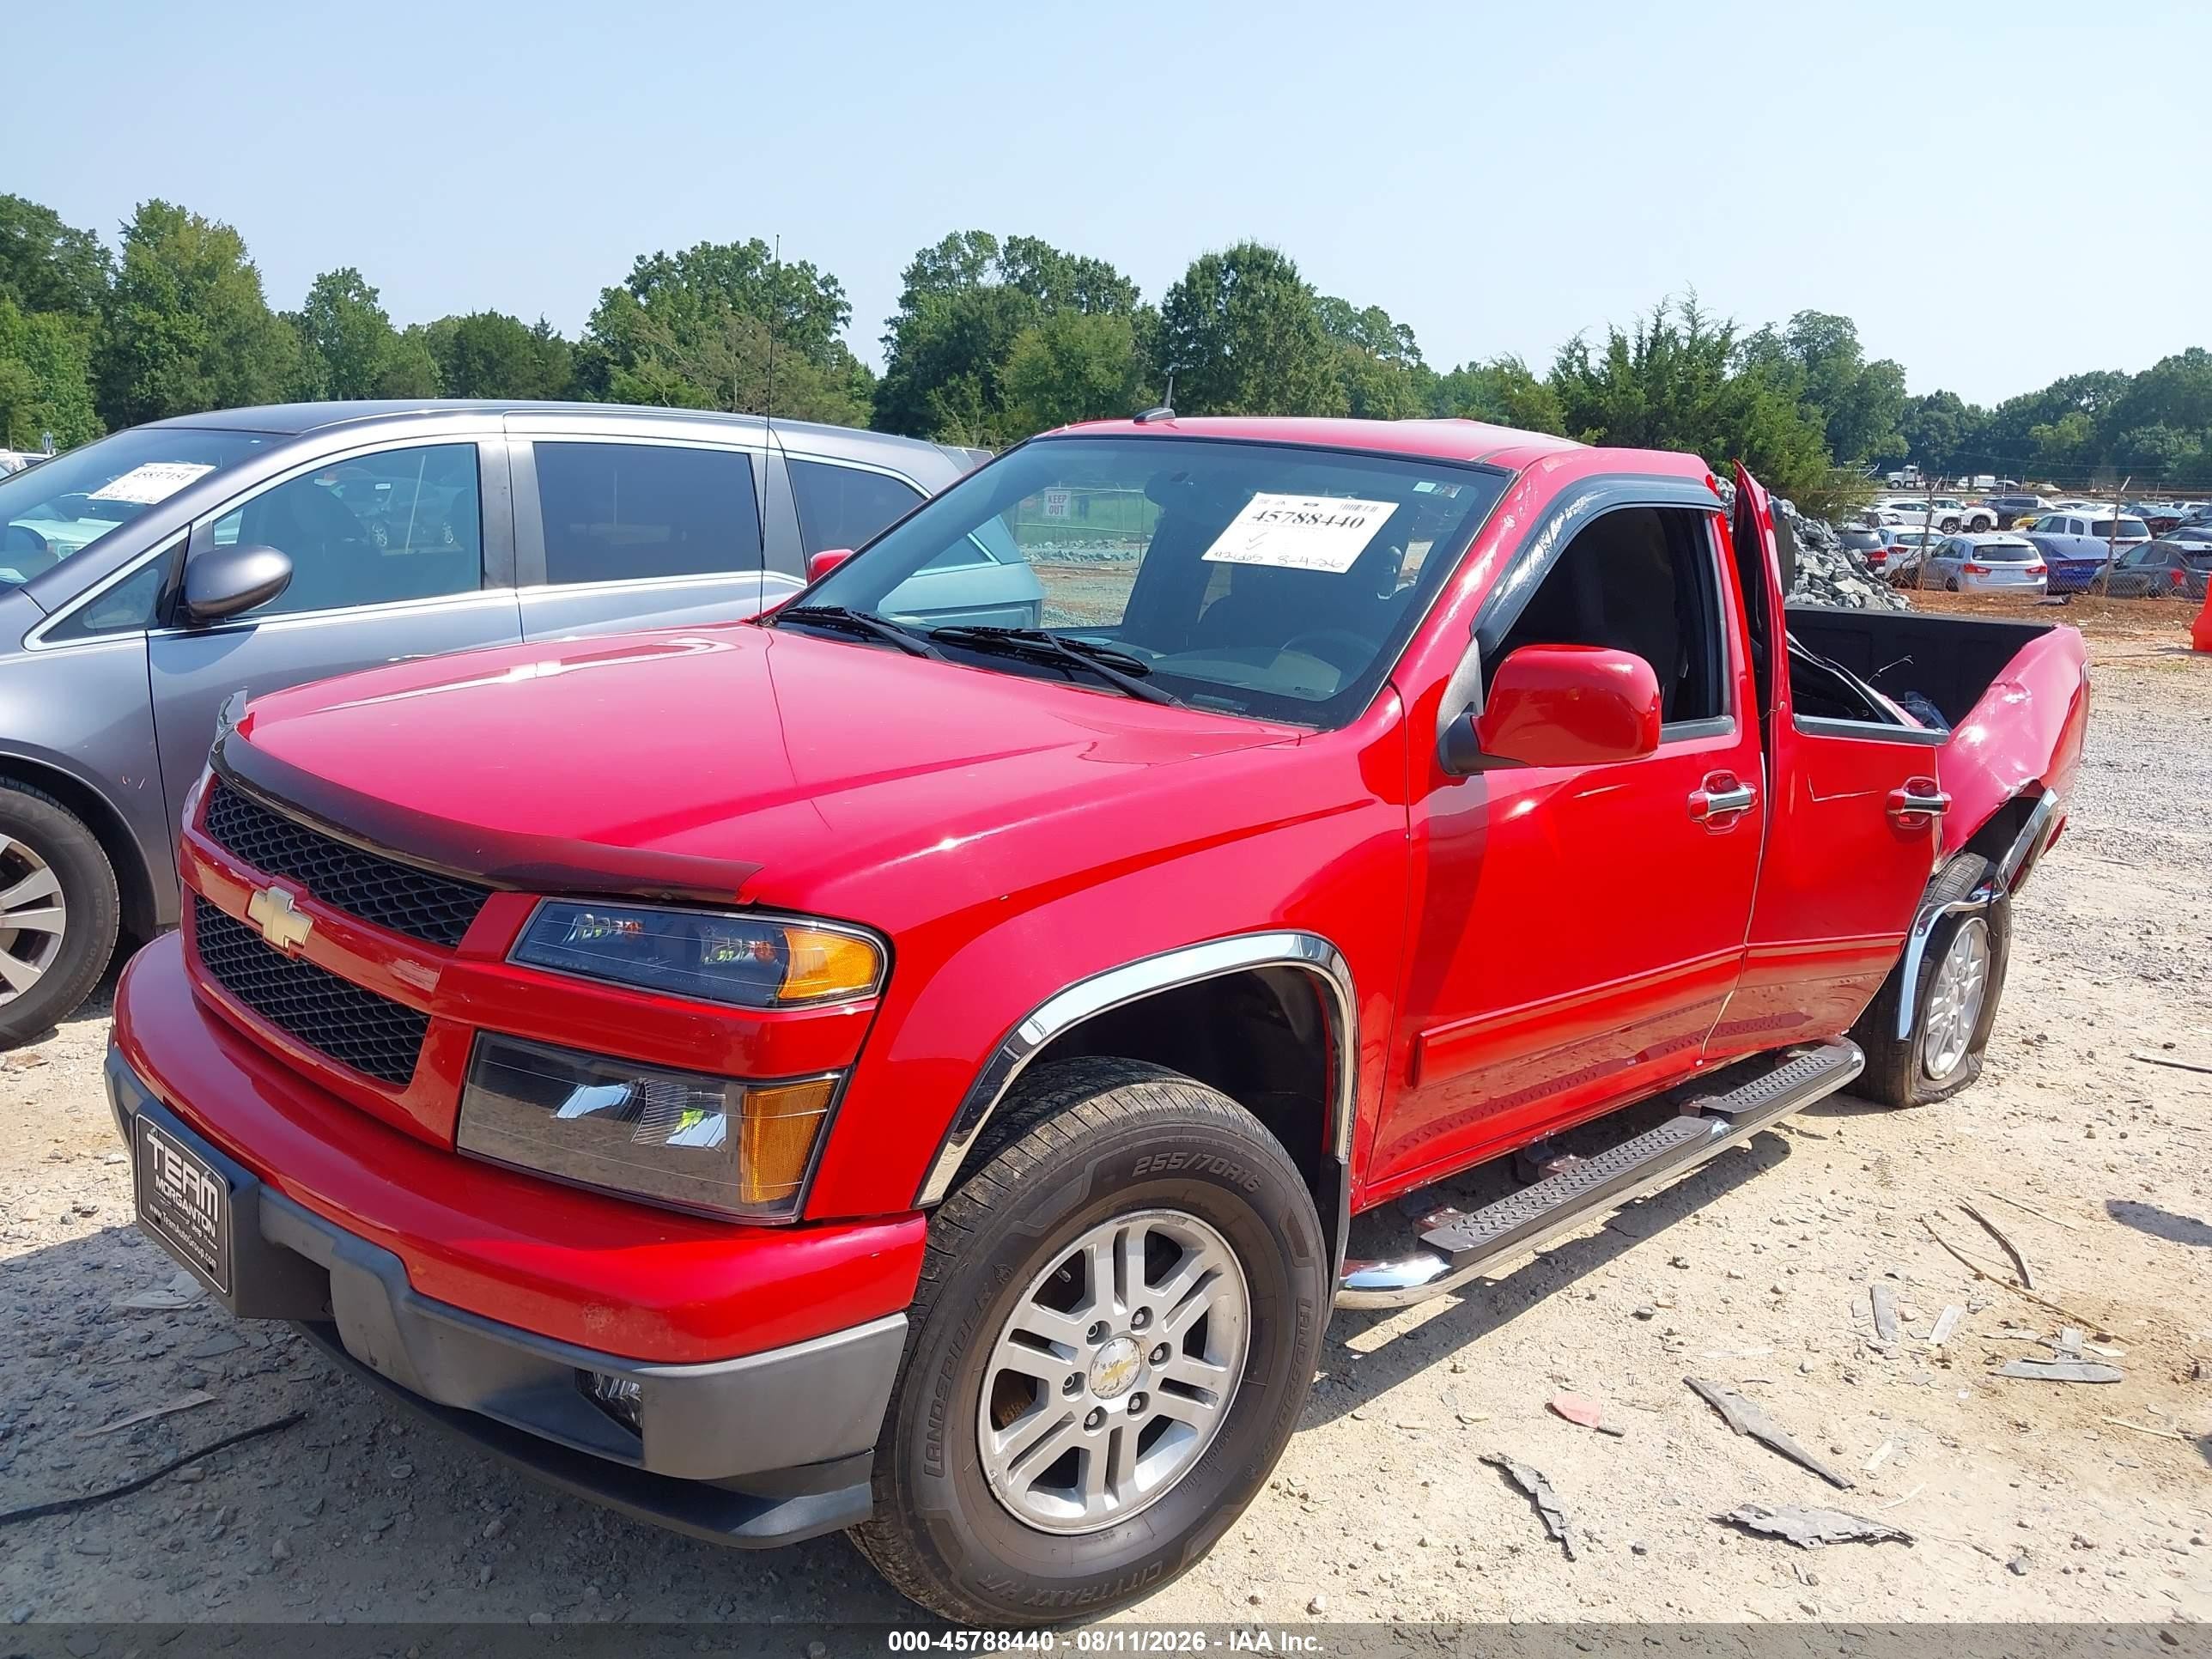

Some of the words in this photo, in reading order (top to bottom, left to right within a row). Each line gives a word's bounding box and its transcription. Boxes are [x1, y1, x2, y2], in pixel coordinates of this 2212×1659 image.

[1048, 495, 1066, 504] KEEP
[1048, 505, 1065, 515] OUT
[1252, 510, 1365, 529] 45788440
[147, 1133, 218, 1222] TEAM
[1132, 1152, 1264, 1193] 255/70R16
[155, 1174, 216, 1237] MORGANTON
[149, 1202, 217, 1270] www.TeamAutoGroup.com
